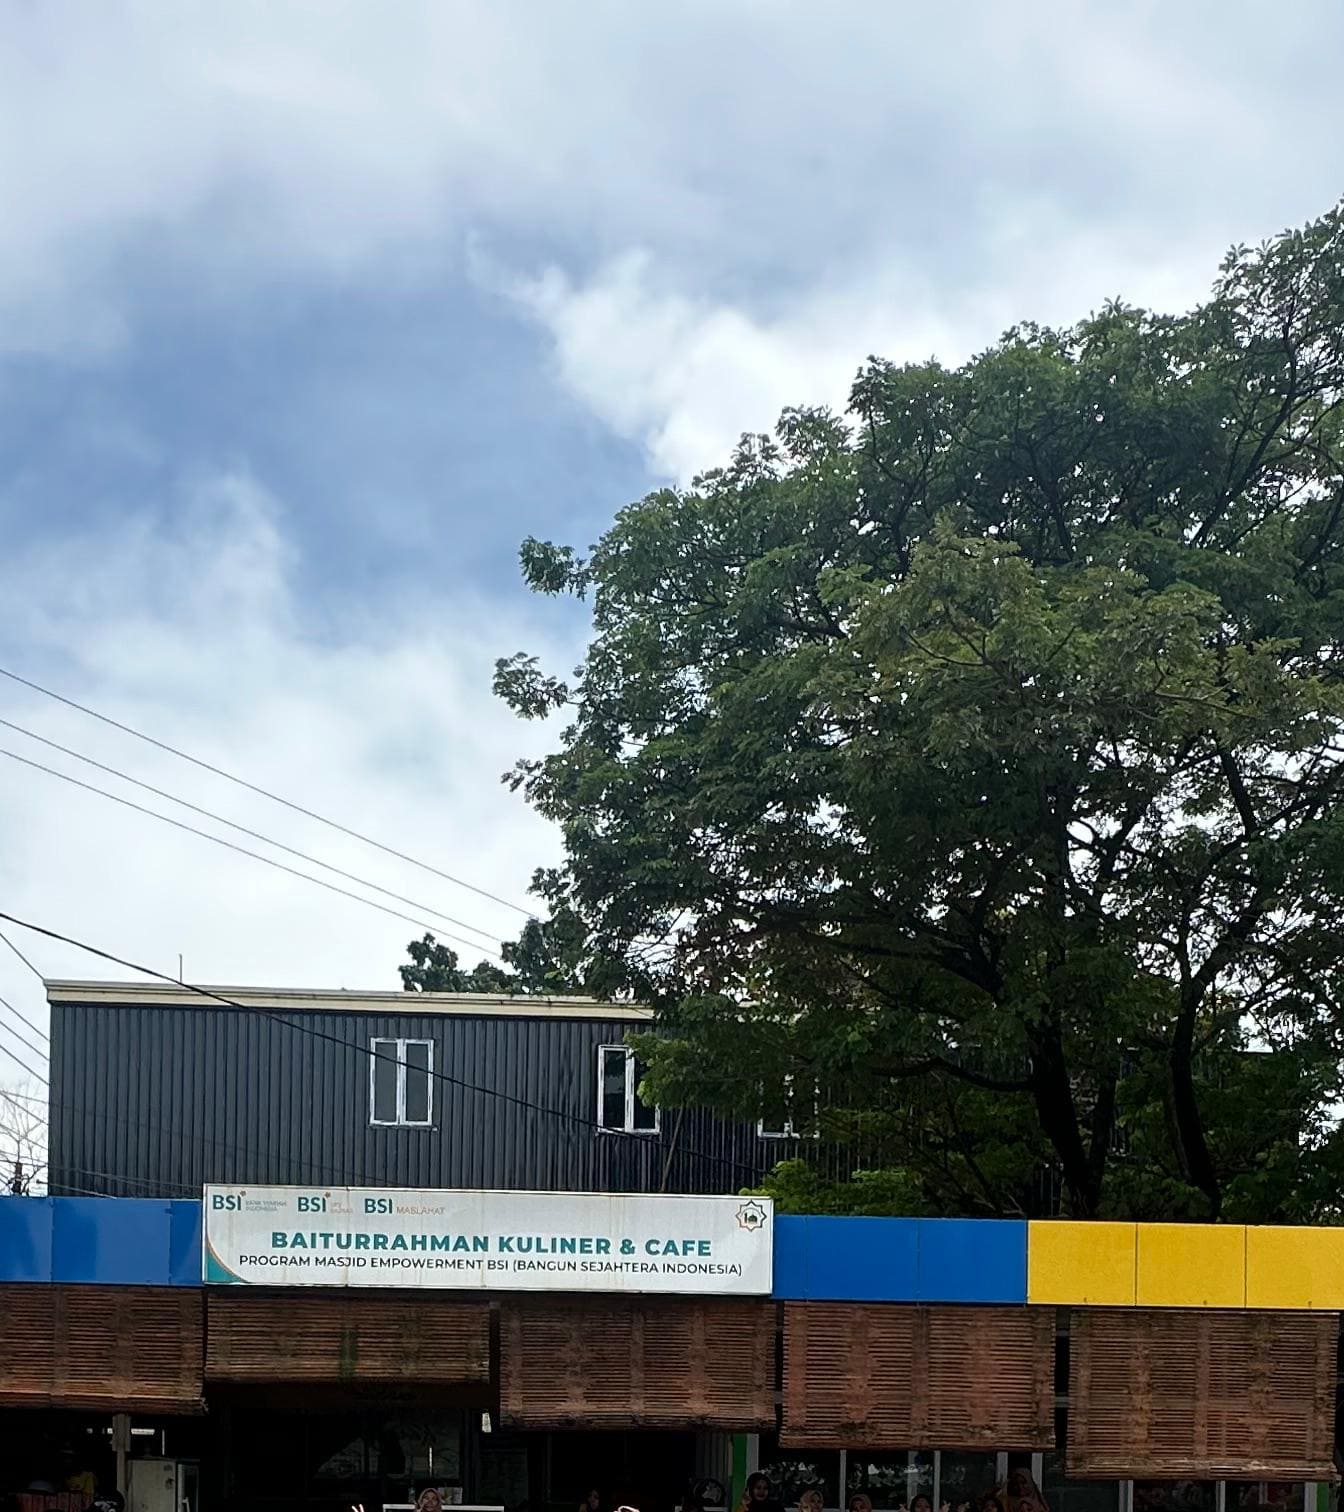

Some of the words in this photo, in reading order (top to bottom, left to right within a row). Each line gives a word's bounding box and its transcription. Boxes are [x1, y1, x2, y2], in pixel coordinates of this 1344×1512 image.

[212, 1194, 242, 1211] BSI
[297, 1196, 326, 1212] BSI
[364, 1198, 393, 1214] BSI
[396, 1206, 446, 1216] MASLAHAT
[271, 1231, 489, 1253] BAITURRAHMAN
[498, 1236, 612, 1255] KULINER
[619, 1239, 636, 1256] &
[644, 1239, 712, 1257] CAFE
[239, 1254, 310, 1266] PROGRAM
[315, 1256, 367, 1268] MASJID
[371, 1257, 483, 1270] EMPOWERMENT
[487, 1260, 508, 1270] BSI
[513, 1260, 577, 1272] (BANGUN
[580, 1261, 659, 1274] SEJAHTERA
[662, 1263, 743, 1276] INDONESIA)
